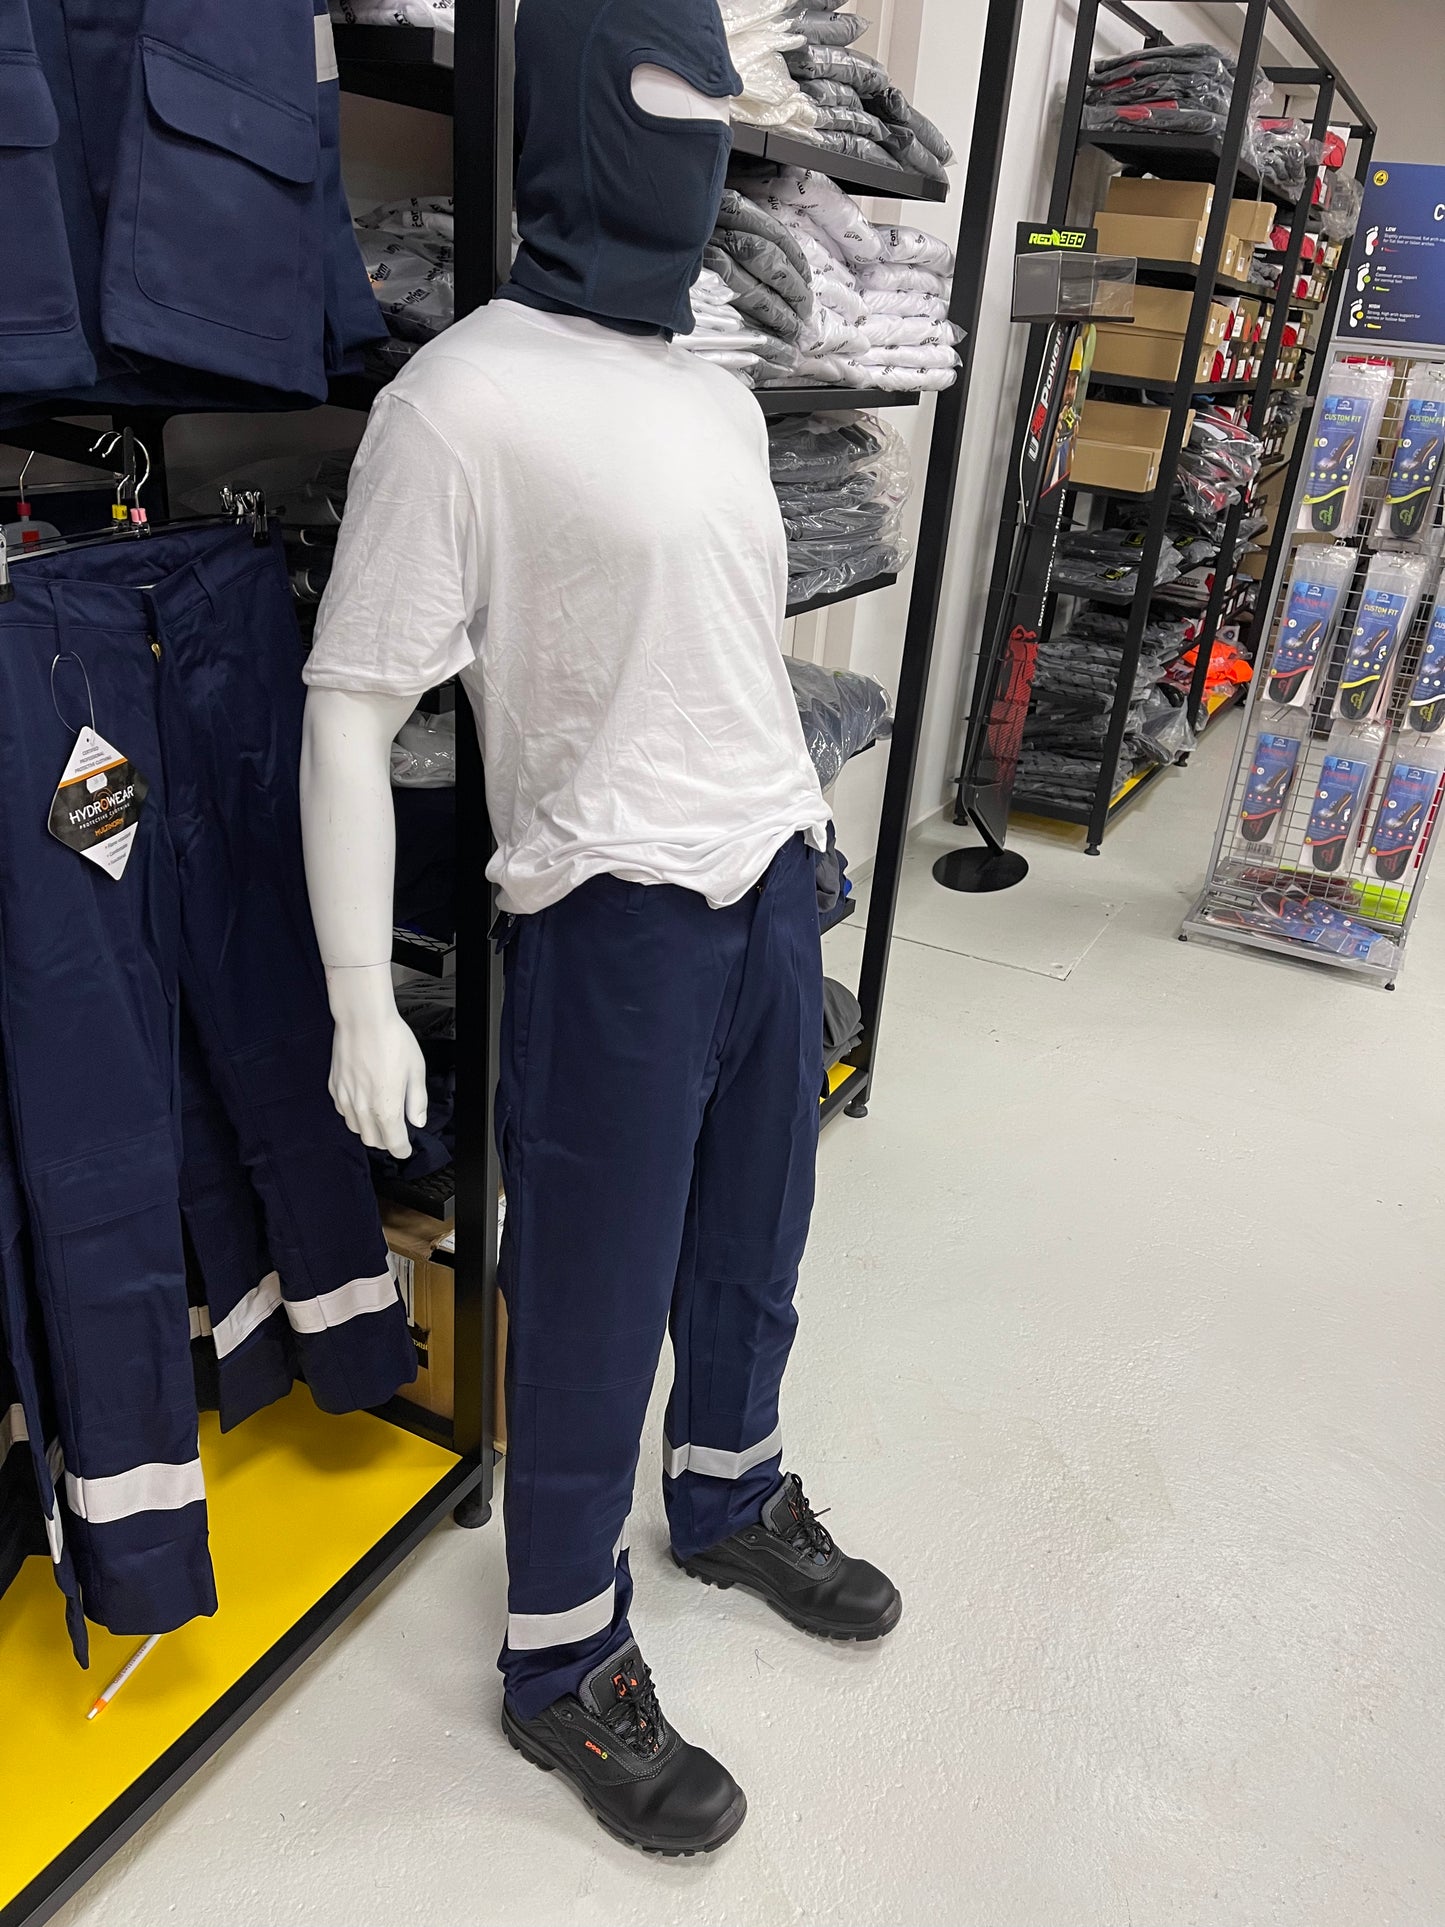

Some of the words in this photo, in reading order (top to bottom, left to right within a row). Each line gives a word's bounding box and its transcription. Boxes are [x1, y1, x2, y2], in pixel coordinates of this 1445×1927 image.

[1324, 413, 1350, 422] CUSTOM
[1350, 415, 1362, 423] FIT
[1409, 414, 1435, 424] CUSTOM
[1363, 604, 1388, 614] CUSTOM
[1388, 607, 1399, 617] FIT
[69, 785, 134, 825] HYDROWEAR
[79, 813, 108, 830] PROTECTIVE
[109, 803, 130, 817] CLOTHING
[95, 817, 125, 837] MULTINORM
